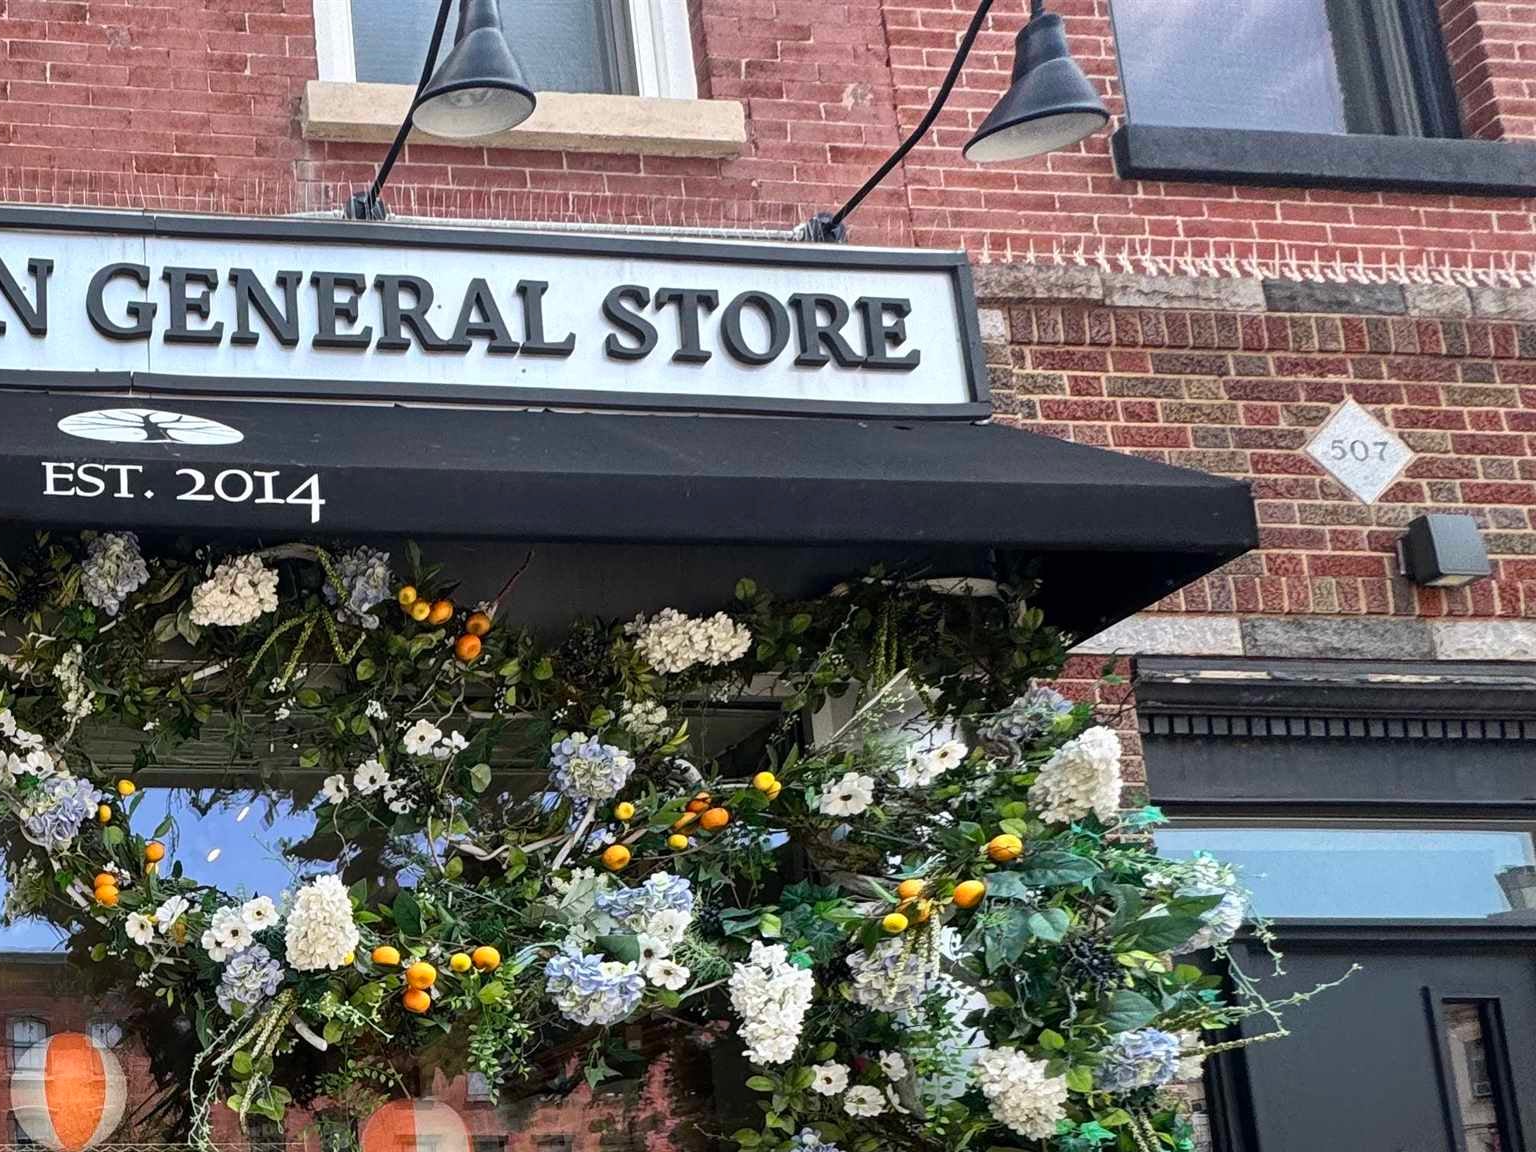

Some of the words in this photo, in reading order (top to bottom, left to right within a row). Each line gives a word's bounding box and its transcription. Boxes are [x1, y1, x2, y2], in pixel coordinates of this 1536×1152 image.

[85, 262, 576, 357] GENERAL
[603, 284, 921, 371] STORE
[1329, 438, 1388, 463] 507
[41, 461, 154, 500] EST.
[175, 465, 326, 524] 2014
